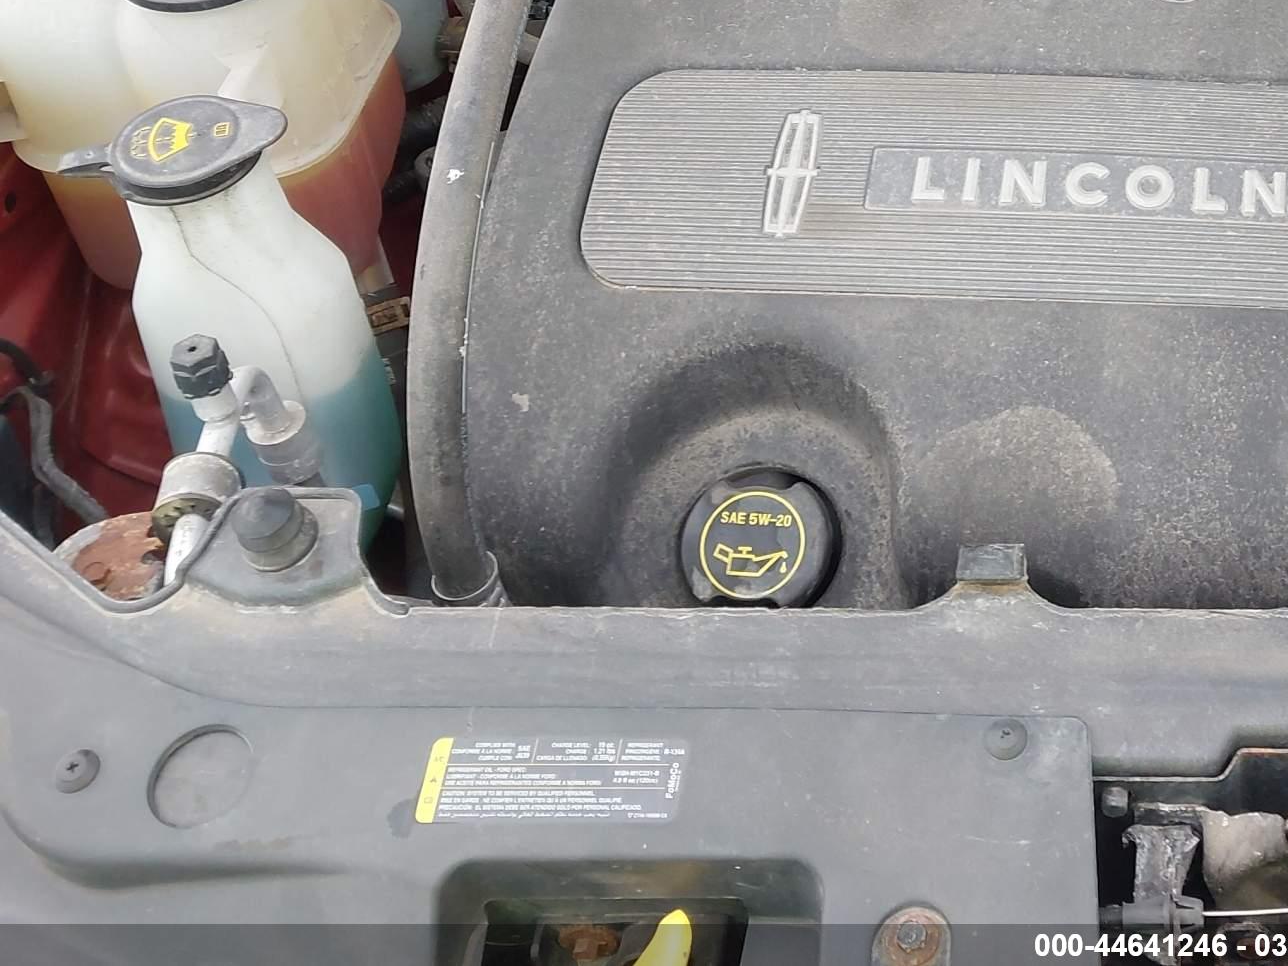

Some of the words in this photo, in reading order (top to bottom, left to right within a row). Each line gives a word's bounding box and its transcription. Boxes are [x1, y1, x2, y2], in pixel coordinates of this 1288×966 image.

[911, 155, 1288, 217] LINCOLN
[720, 512, 746, 524] SAE
[748, 512, 792, 528] 5W-20
